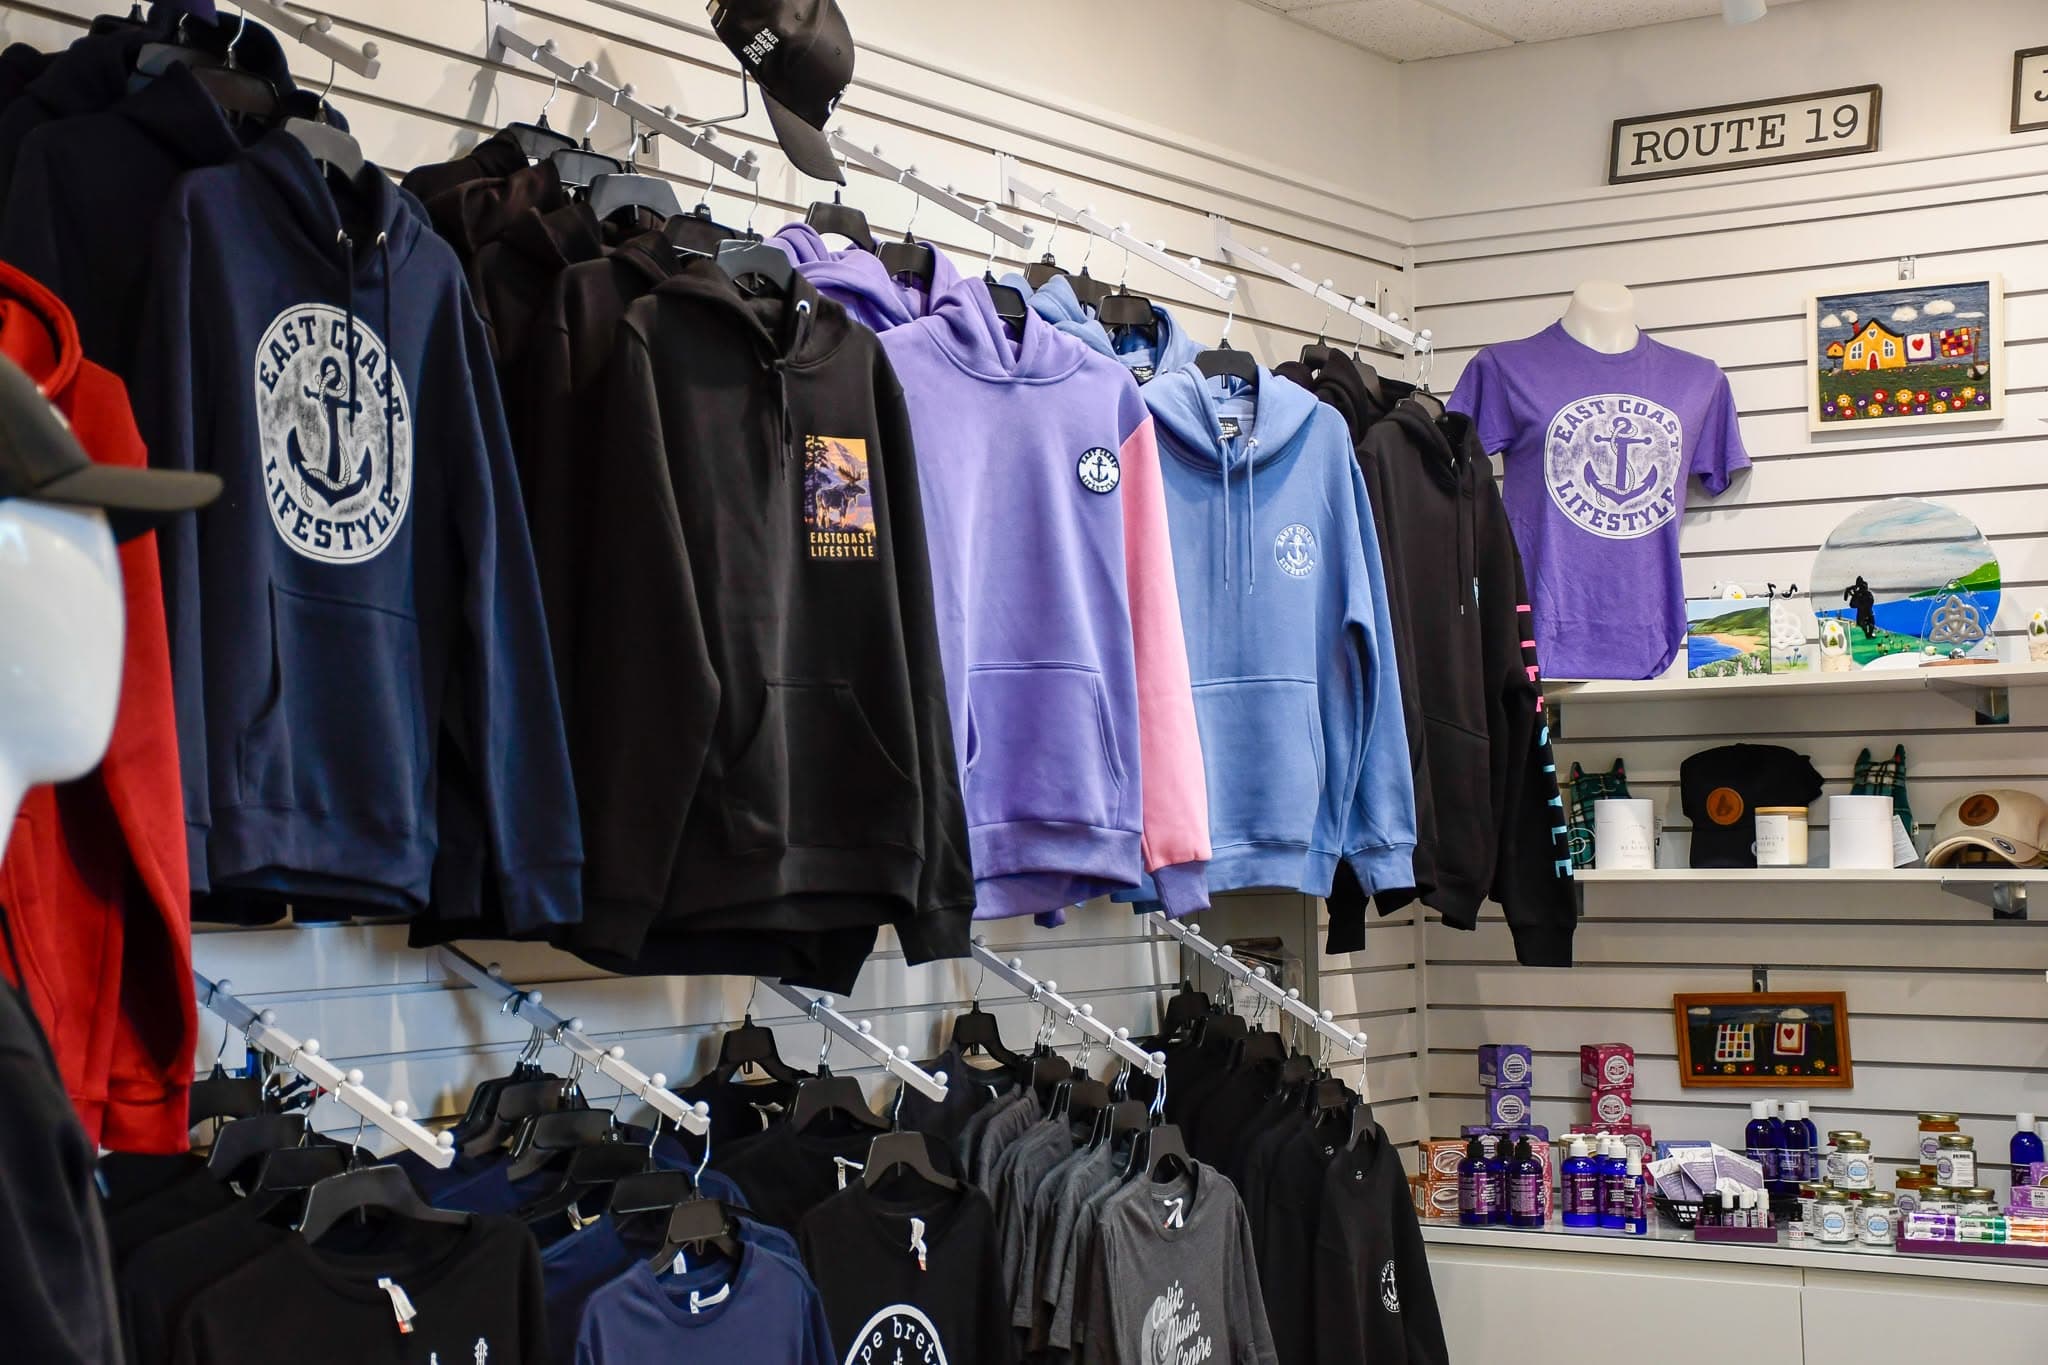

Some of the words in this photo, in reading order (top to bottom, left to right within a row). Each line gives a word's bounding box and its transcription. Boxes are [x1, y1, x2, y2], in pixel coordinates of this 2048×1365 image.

[1630, 113, 1786, 166] ROUTE
[1805, 104, 1859, 143] 19
[260, 315, 317, 394] EAST
[1553, 400, 1605, 444] EAST
[265, 456, 399, 550] LIFESTYLE
[810, 532, 871, 543] EASTCOAST
[811, 545, 874, 557] LIFESTYLE
[1153, 1280, 1184, 1329] Celtic
[1162, 1302, 1200, 1356] Music
